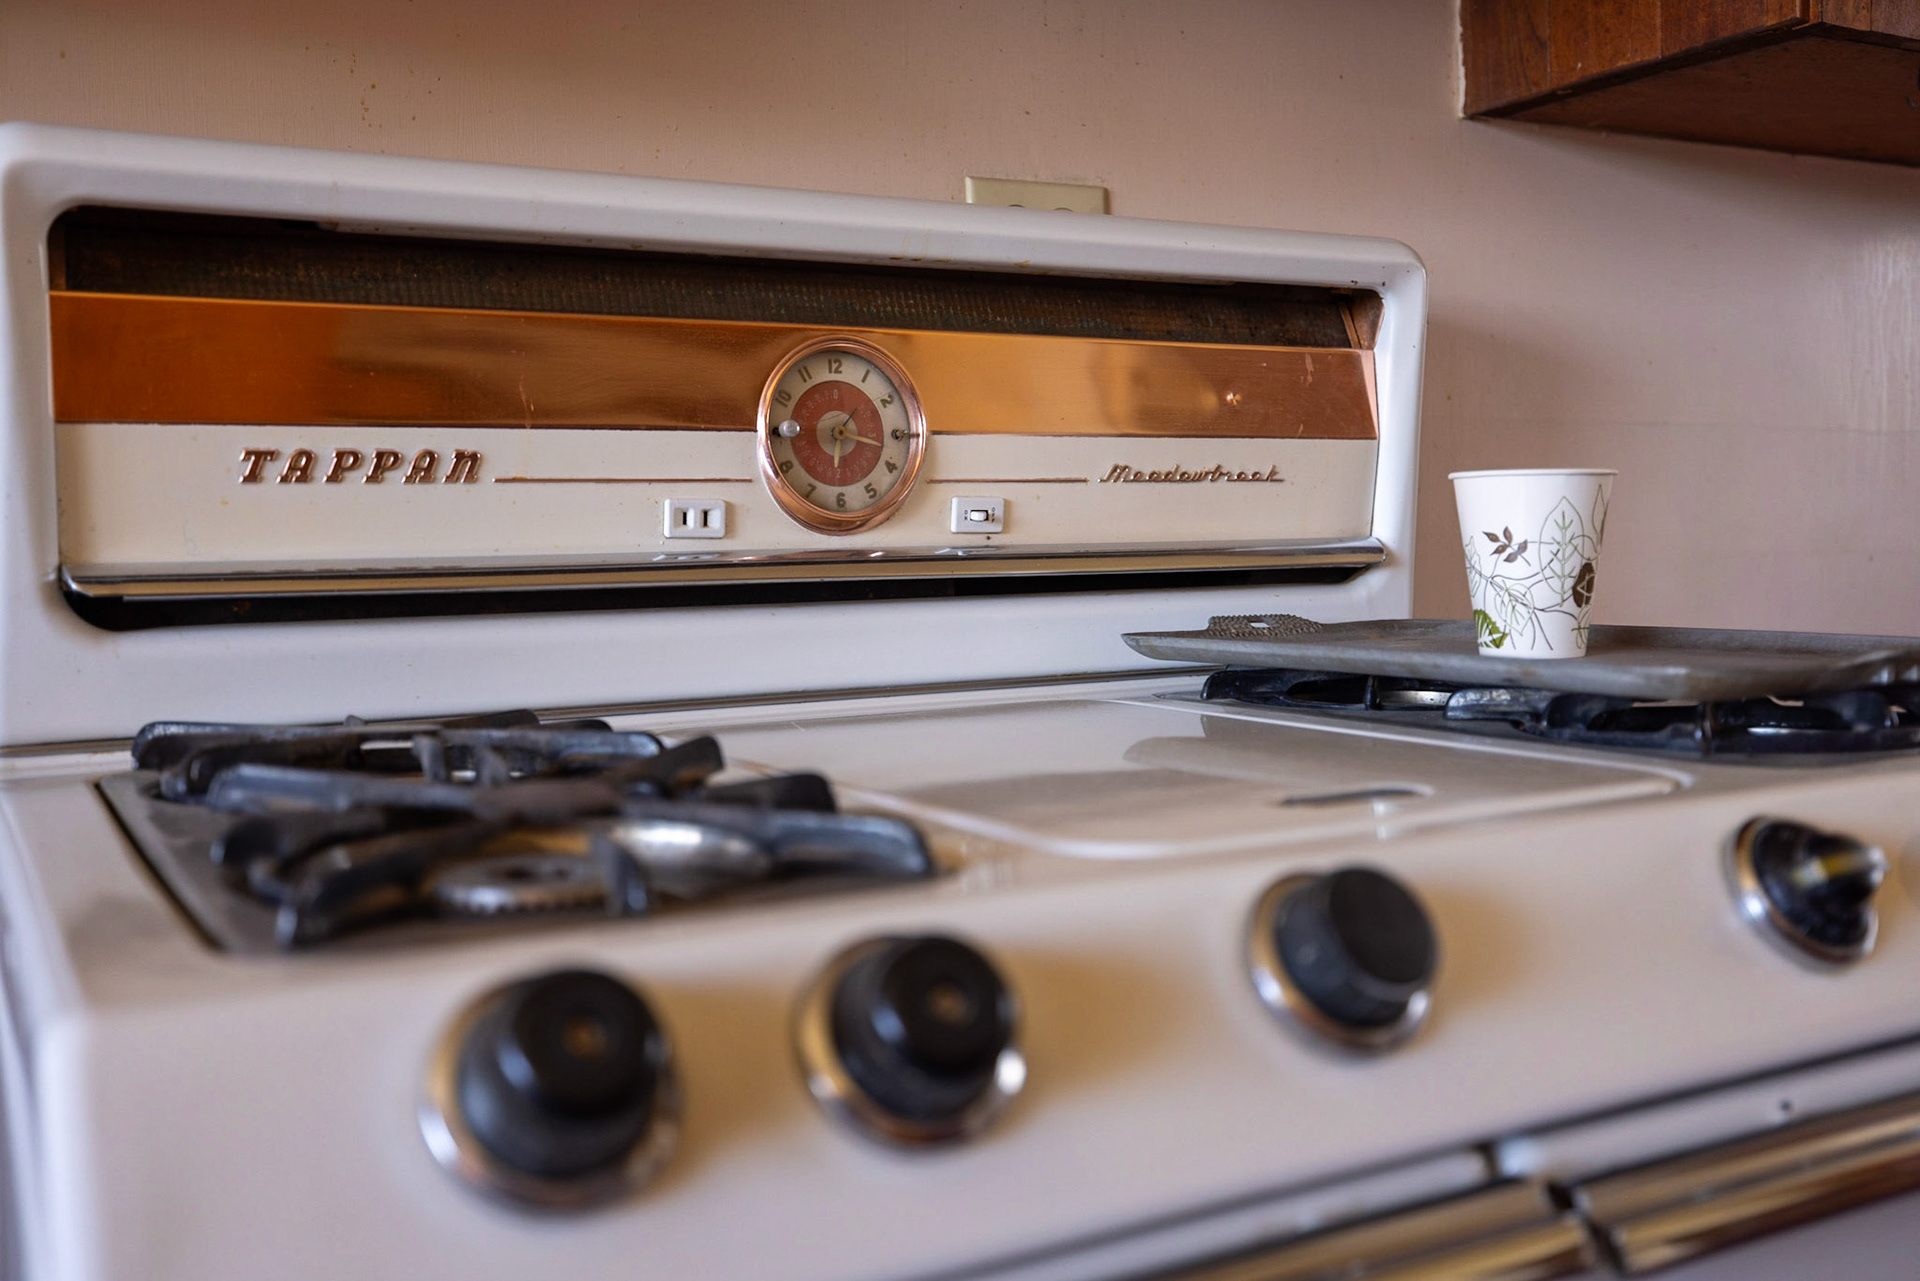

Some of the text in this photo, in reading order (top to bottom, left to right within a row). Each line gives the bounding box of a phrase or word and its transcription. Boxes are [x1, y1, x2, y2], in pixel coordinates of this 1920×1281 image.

[798, 365, 812, 383] 11
[828, 358, 842, 374] 12
[861, 369, 870, 383] 1
[775, 389, 792, 408] 10
[880, 394, 895, 409] 2
[239, 448, 482, 484] TAPPAN
[779, 460, 794, 475] 8
[885, 460, 898, 474] 4
[1098, 463, 1285, 483] Meadowbrook
[804, 484, 817, 499] 7
[864, 483, 877, 499] 5
[836, 492, 847, 509] 6
